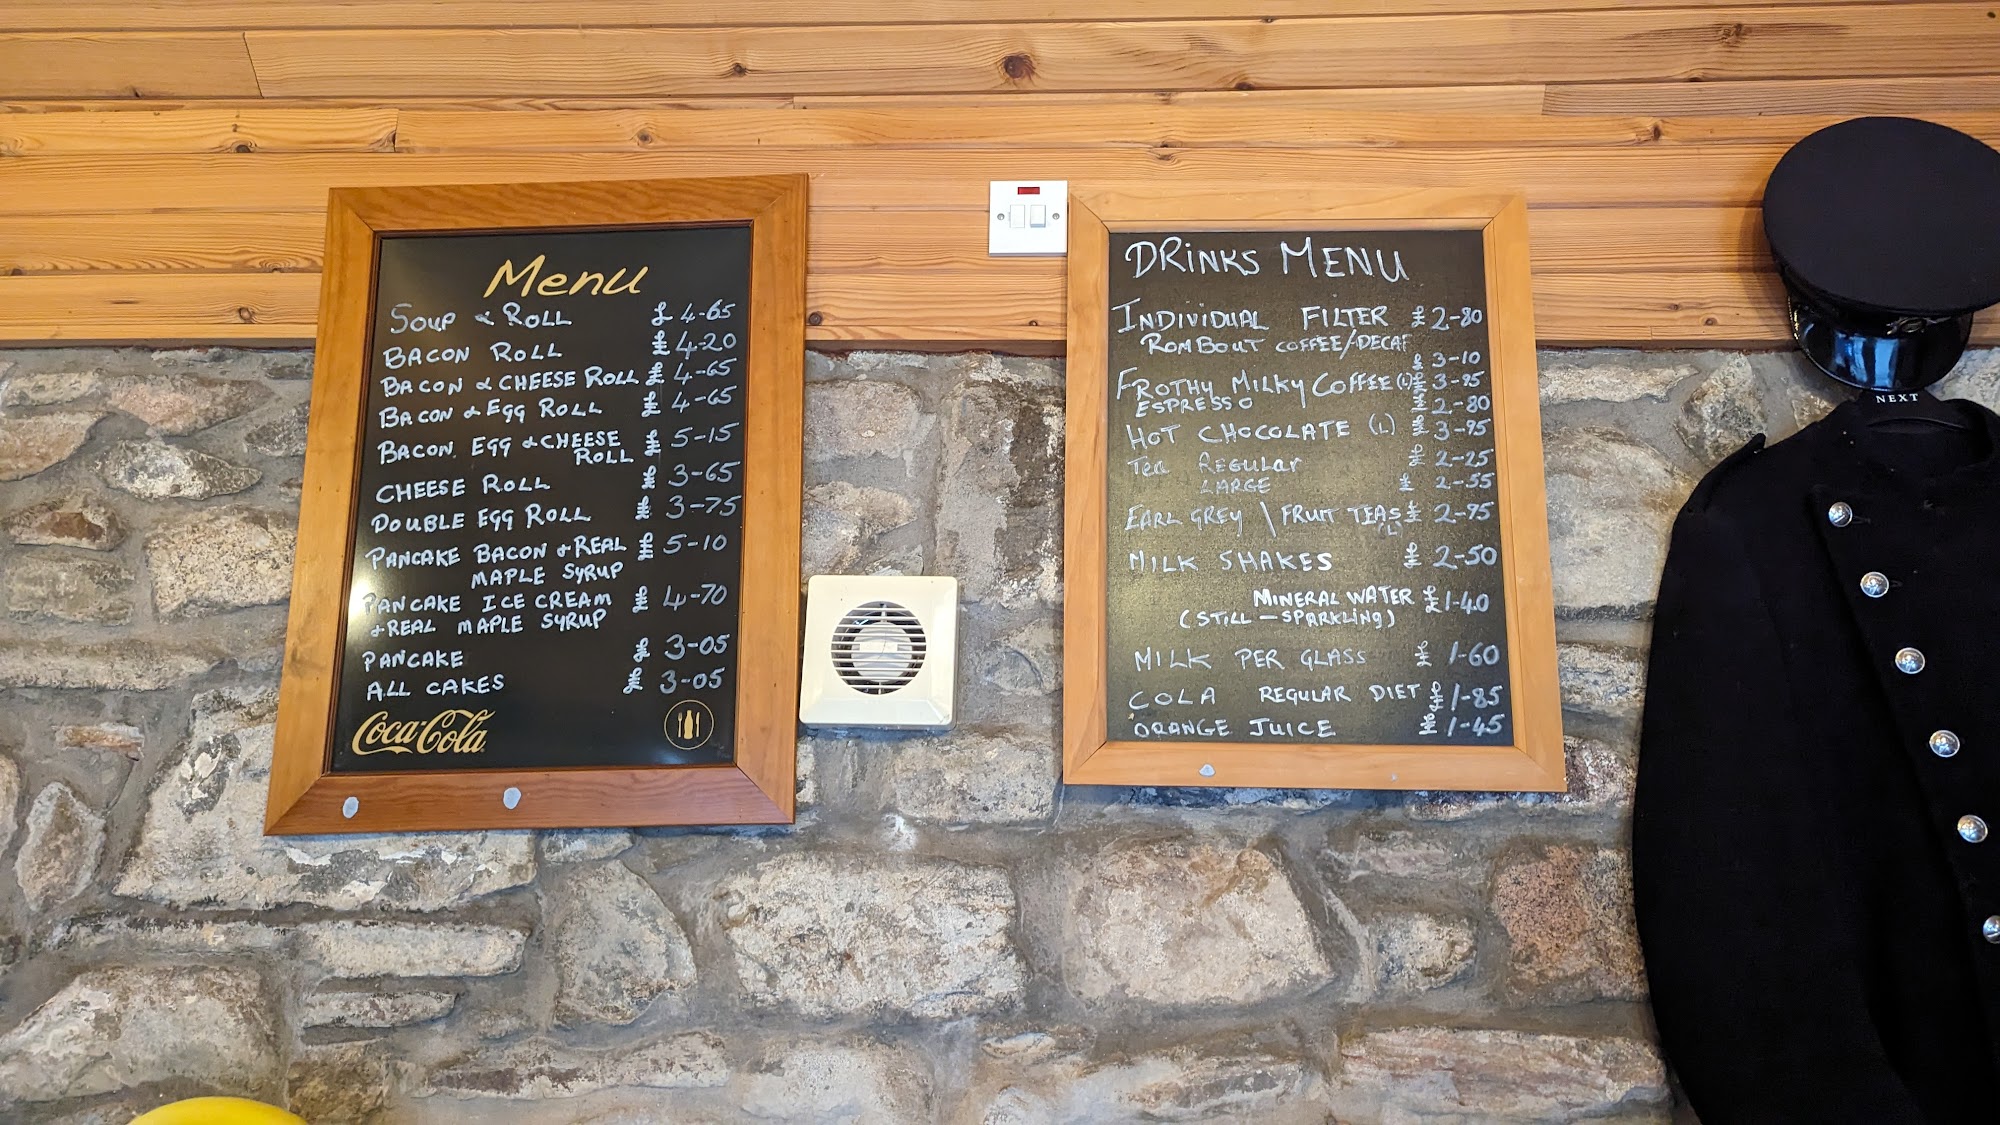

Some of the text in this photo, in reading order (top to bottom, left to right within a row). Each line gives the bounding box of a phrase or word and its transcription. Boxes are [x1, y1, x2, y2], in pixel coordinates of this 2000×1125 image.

[1280, 237, 1409, 282] MENU
[483, 254, 648, 298] Menu
[390, 303, 456, 334] SOUP
[503, 302, 572, 328] ROLL
[1111, 298, 1269, 334] INDIVIDUAL
[1302, 306, 1388, 329] FILTER
[383, 346, 469, 369] BACON
[491, 342, 562, 361] ROLL
[380, 378, 463, 397] BACON
[499, 371, 576, 390] CHEESE
[584, 366, 639, 389] ROLL
[1117, 366, 1214, 401] FROTHY
[1232, 370, 1306, 408] MILKY
[1312, 373, 1393, 397] COFFEE
[1135, 396, 1253, 417] ESPRESSO
[1876, 393, 1919, 404] NEXT
[379, 406, 453, 429] BACON
[539, 399, 602, 418] ROLL
[541, 431, 620, 450] CHEESE
[1126, 424, 1181, 450] HOT
[1198, 420, 1351, 443] CHOCOLATE
[576, 447, 634, 465] ROLL
[1128, 458, 1169, 475] Tea
[375, 478, 465, 503] CHEESE
[483, 474, 550, 493] ROLL
[1200, 476, 1271, 495] LARGE
[371, 512, 465, 534] DOUBLE
[525, 503, 592, 527] ROLL
[1124, 504, 1183, 530] EARL
[1190, 505, 1243, 538] GREY
[1282, 504, 1340, 526] FRUIT
[1348, 503, 1402, 526] TEAS
[365, 547, 460, 570] PANCAKE
[473, 543, 547, 565] BACON
[574, 536, 627, 556] REAL
[1129, 552, 1198, 572] MILK
[1219, 552, 1333, 571] SHAKES
[471, 562, 624, 590] MAPLE SYRUP
[362, 593, 460, 614] PANCAKE
[483, 596, 525, 610] ICE
[536, 593, 611, 608] CREAM
[1253, 589, 1338, 607] MINERAL
[1347, 585, 1415, 606] WATER
[388, 620, 435, 637] REAL
[458, 617, 523, 635] MAPLE
[541, 609, 607, 631] SYRUP
[363, 651, 464, 672] PANCAKE
[1134, 647, 1212, 672] MILK
[1235, 648, 1285, 668] PER
[1301, 649, 1366, 668] GLASS
[367, 681, 411, 701] ALL
[426, 674, 505, 696] CAKES
[1129, 687, 1216, 711] COLA
[1259, 686, 1351, 703] REGULAR
[1370, 684, 1421, 701] DIET
[351, 709, 495, 756] Coca-Cola
[1134, 719, 1231, 737] ORANGE
[1250, 718, 1335, 737] JUICE
